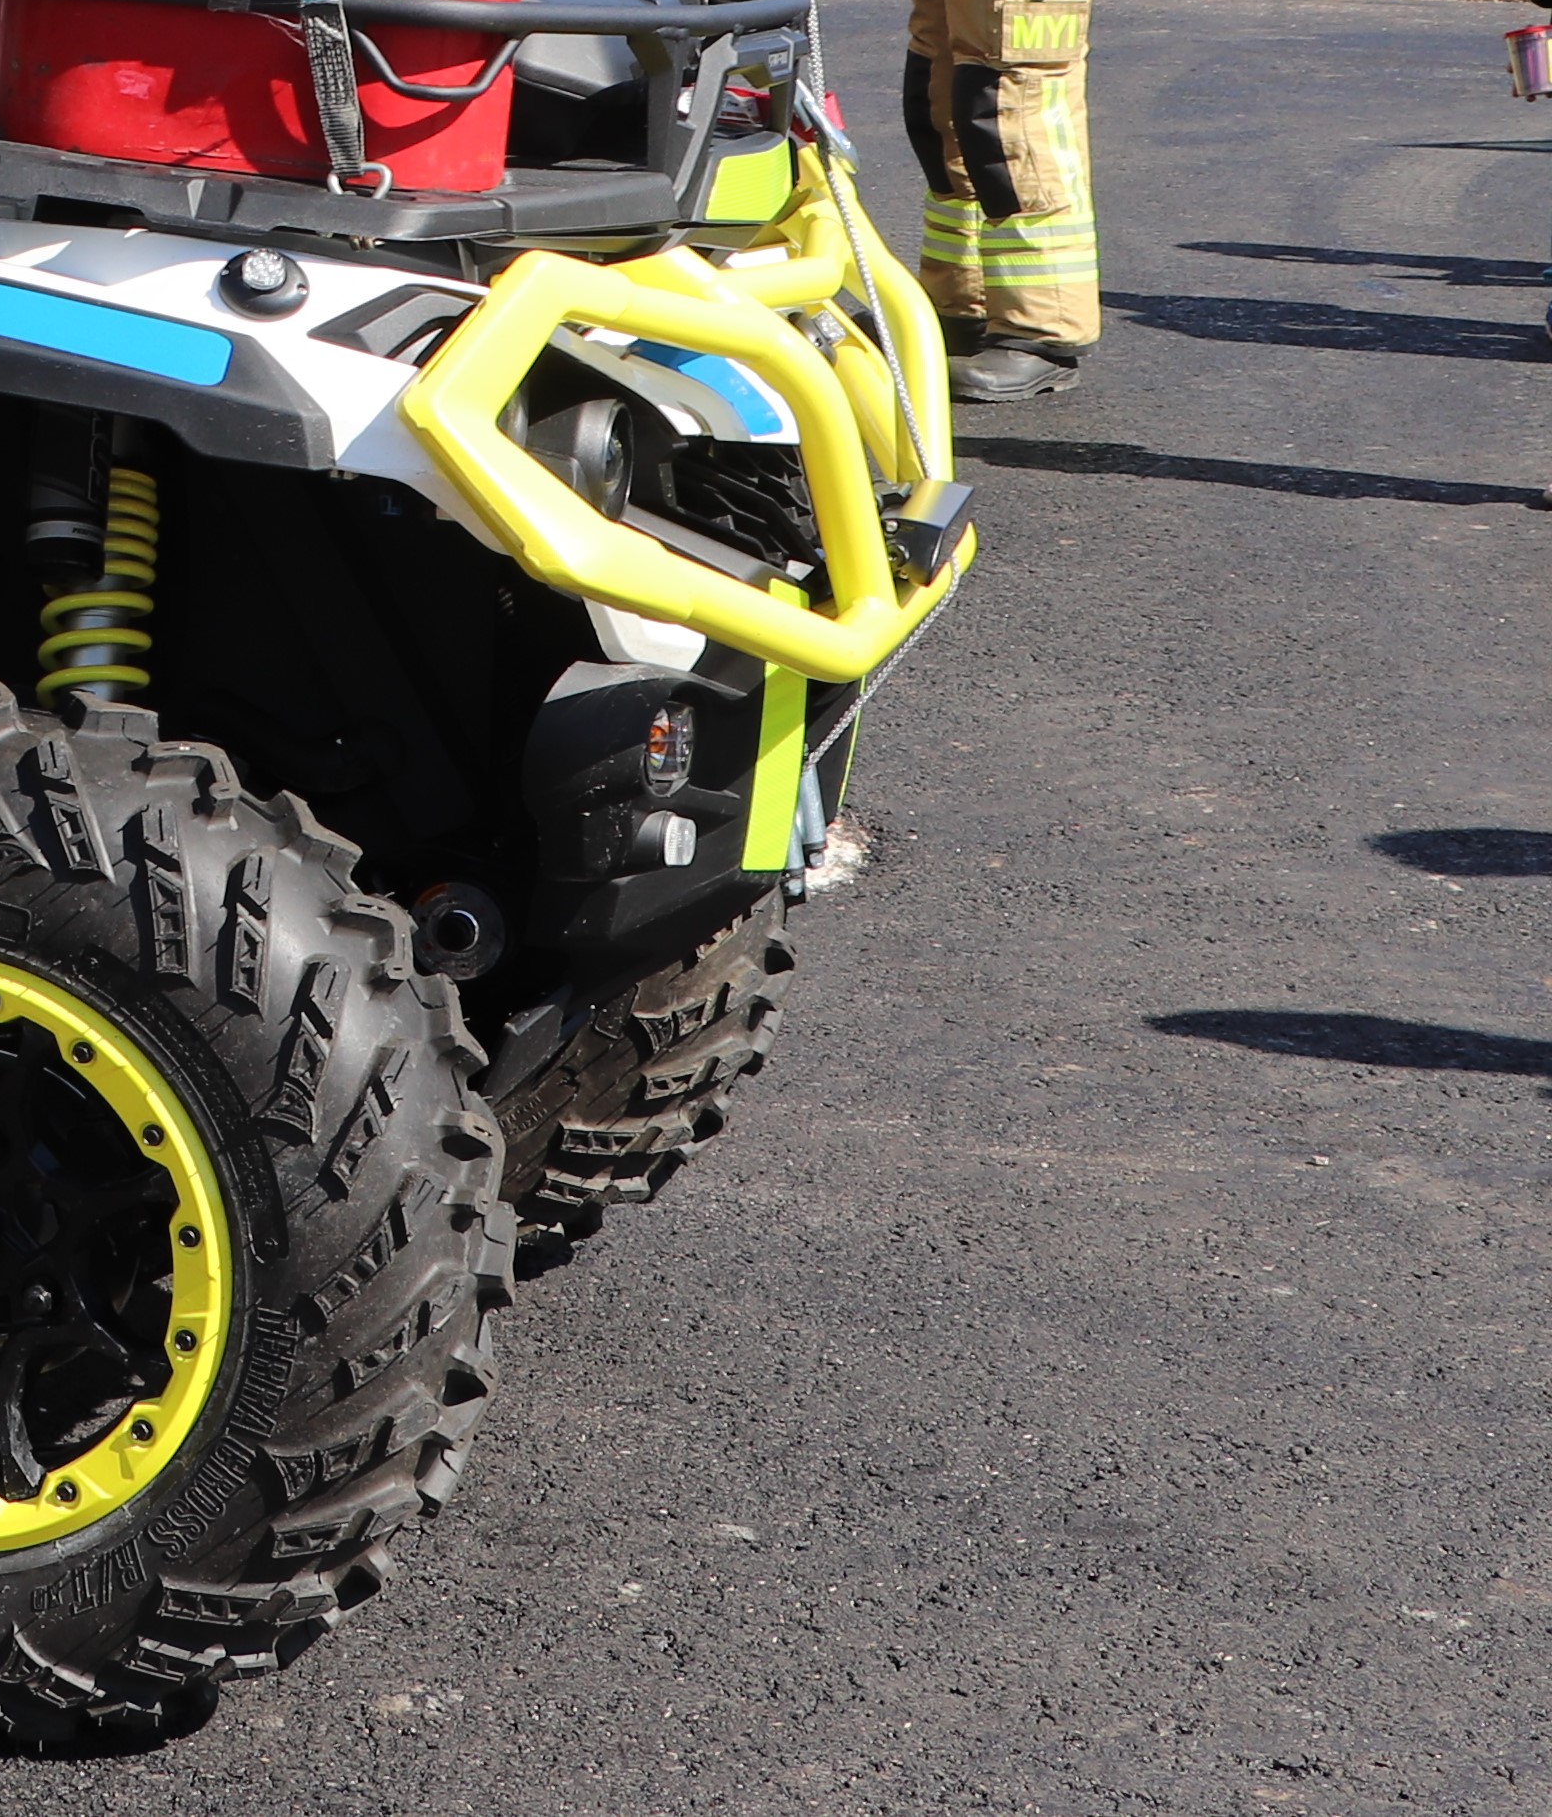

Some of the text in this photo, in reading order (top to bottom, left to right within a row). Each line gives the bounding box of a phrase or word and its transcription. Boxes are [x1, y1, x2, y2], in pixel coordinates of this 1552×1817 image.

[1013, 14, 1078, 49] MYI
[235, 1304, 301, 1439] TERRA
[146, 1436, 258, 1563] CROSS
